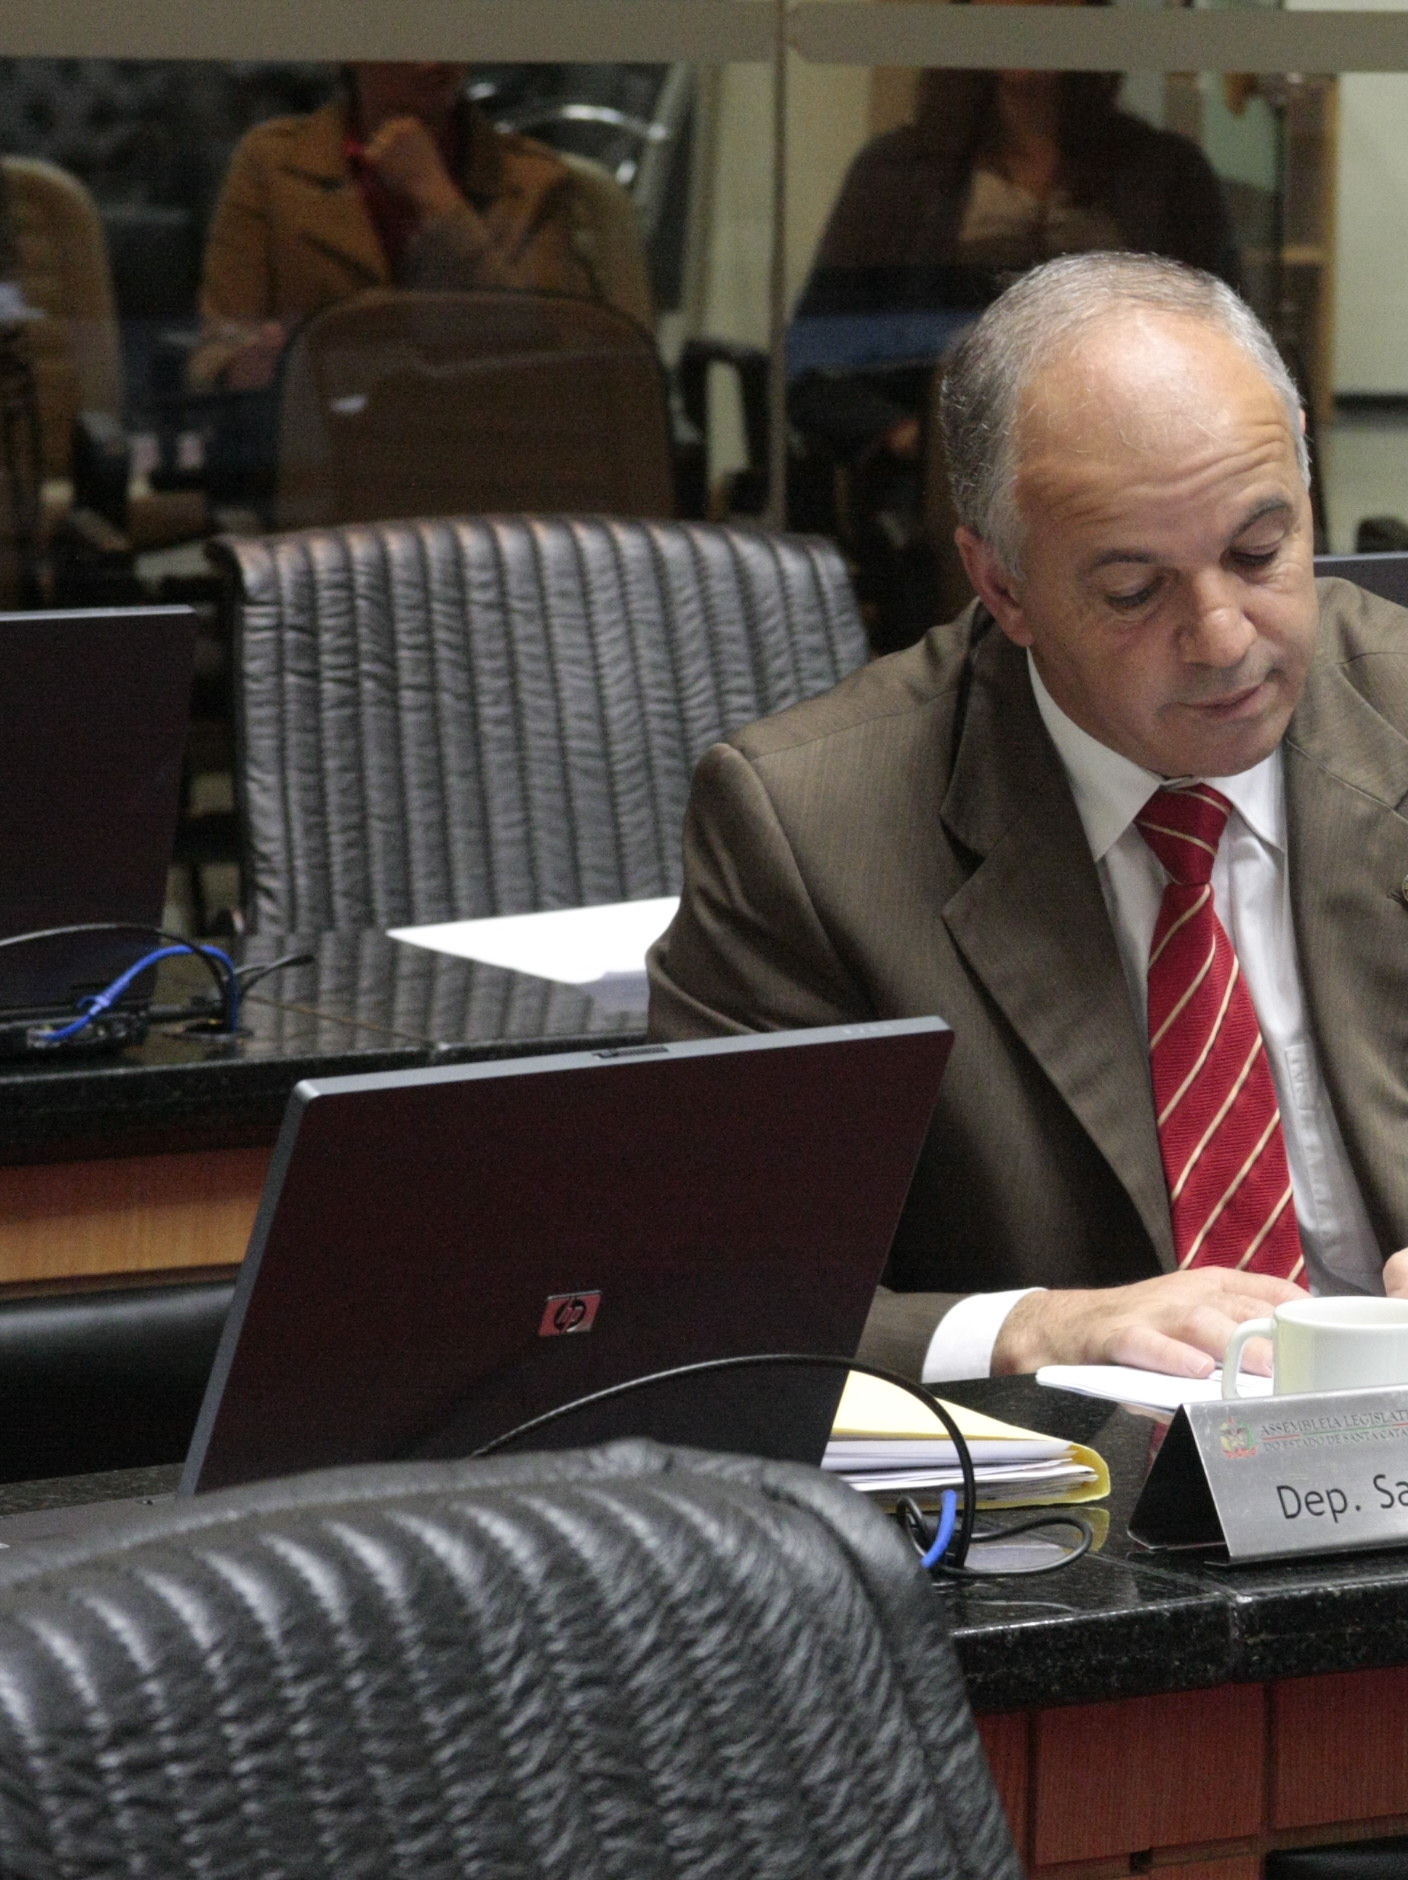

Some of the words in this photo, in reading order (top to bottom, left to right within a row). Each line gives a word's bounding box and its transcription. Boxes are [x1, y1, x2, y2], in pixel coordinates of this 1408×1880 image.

[1262, 1416, 1342, 1436] ASSEMBLEIA
[1263, 1440, 1281, 1452] DO
[1282, 1435, 1325, 1450] ESTADO
[1326, 1434, 1342, 1446] DE
[1342, 1430, 1379, 1444] SANTA
[1276, 1484, 1361, 1524] Dep.
